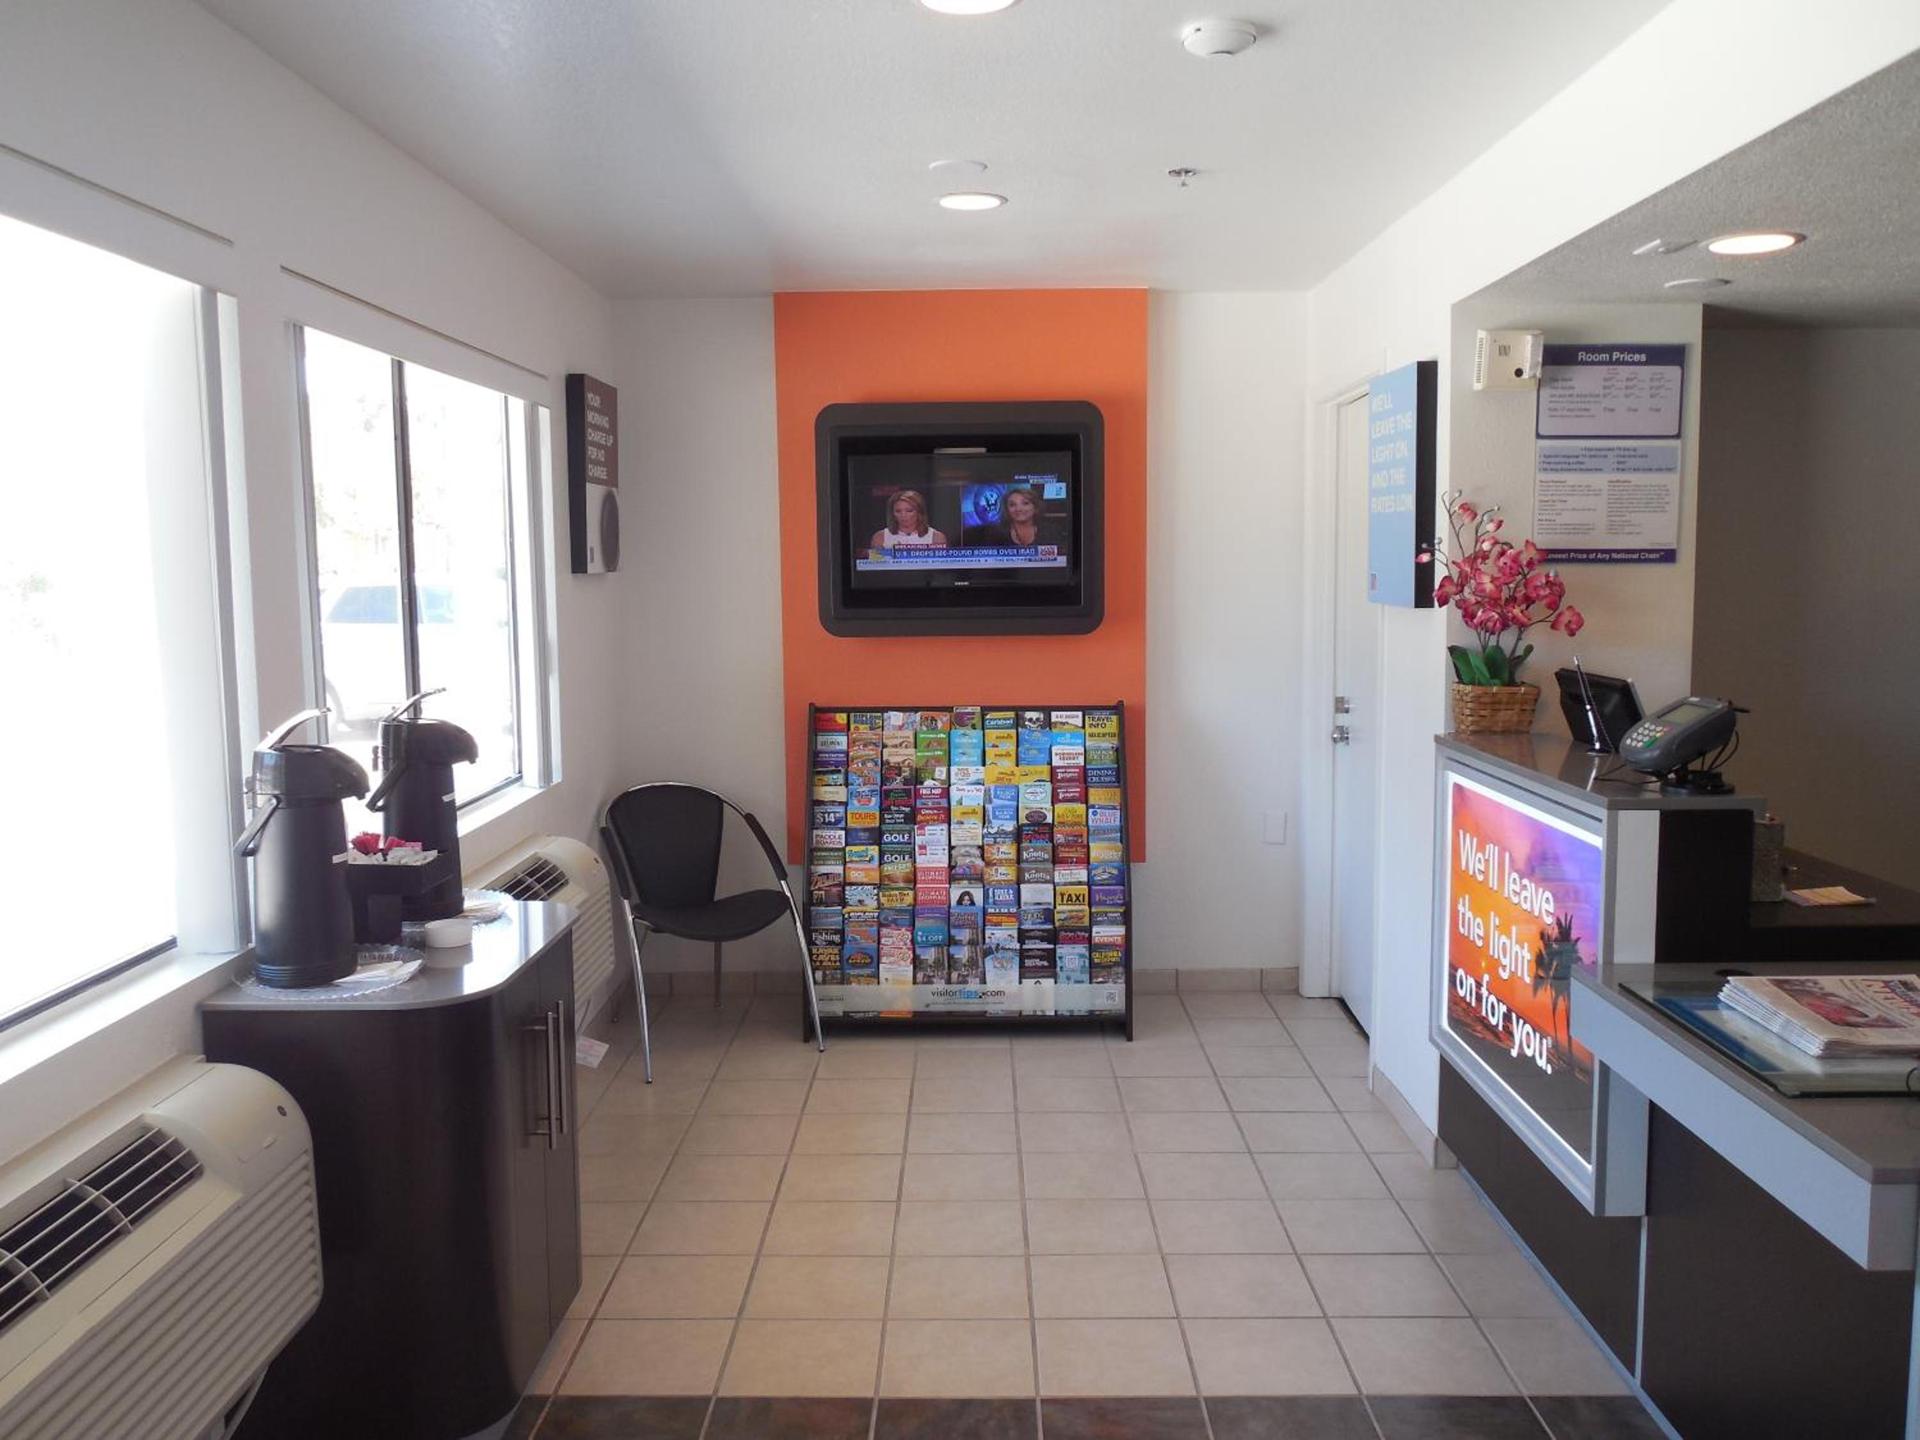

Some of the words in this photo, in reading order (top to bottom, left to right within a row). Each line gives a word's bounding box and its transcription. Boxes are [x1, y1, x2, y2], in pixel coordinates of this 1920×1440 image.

[1578, 352, 1609, 361] Room
[1613, 352, 1647, 361] Prices
[587, 392, 600, 408] YOUR
[587, 410, 609, 428] MORNING
[1372, 417, 1395, 439] LEAVE
[1396, 411, 1412, 432] THE
[588, 428, 606, 445] CHARGE
[607, 433, 613, 446] UP
[1372, 443, 1395, 464] LIGHT
[1396, 439, 1408, 458] ON
[588, 463, 608, 480] CHARGE
[1570, 552, 1587, 560] Price
[1597, 552, 1610, 561] Any
[1611, 552, 1639, 560] National
[850, 812, 877, 820] TOURS
[883, 833, 910, 842] GOLF
[884, 854, 909, 862] GOLF
[1459, 829, 1499, 891] We'll
[1503, 852, 1554, 924] leave
[1060, 892, 1085, 903] TAXI
[812, 932, 841, 943] Fishing
[1457, 896, 1484, 948] the
[1488, 911, 1531, 985] light
[1456, 966, 1476, 1007] on
[1480, 973, 1508, 1033] for
[1510, 1012, 1553, 1076] you.
